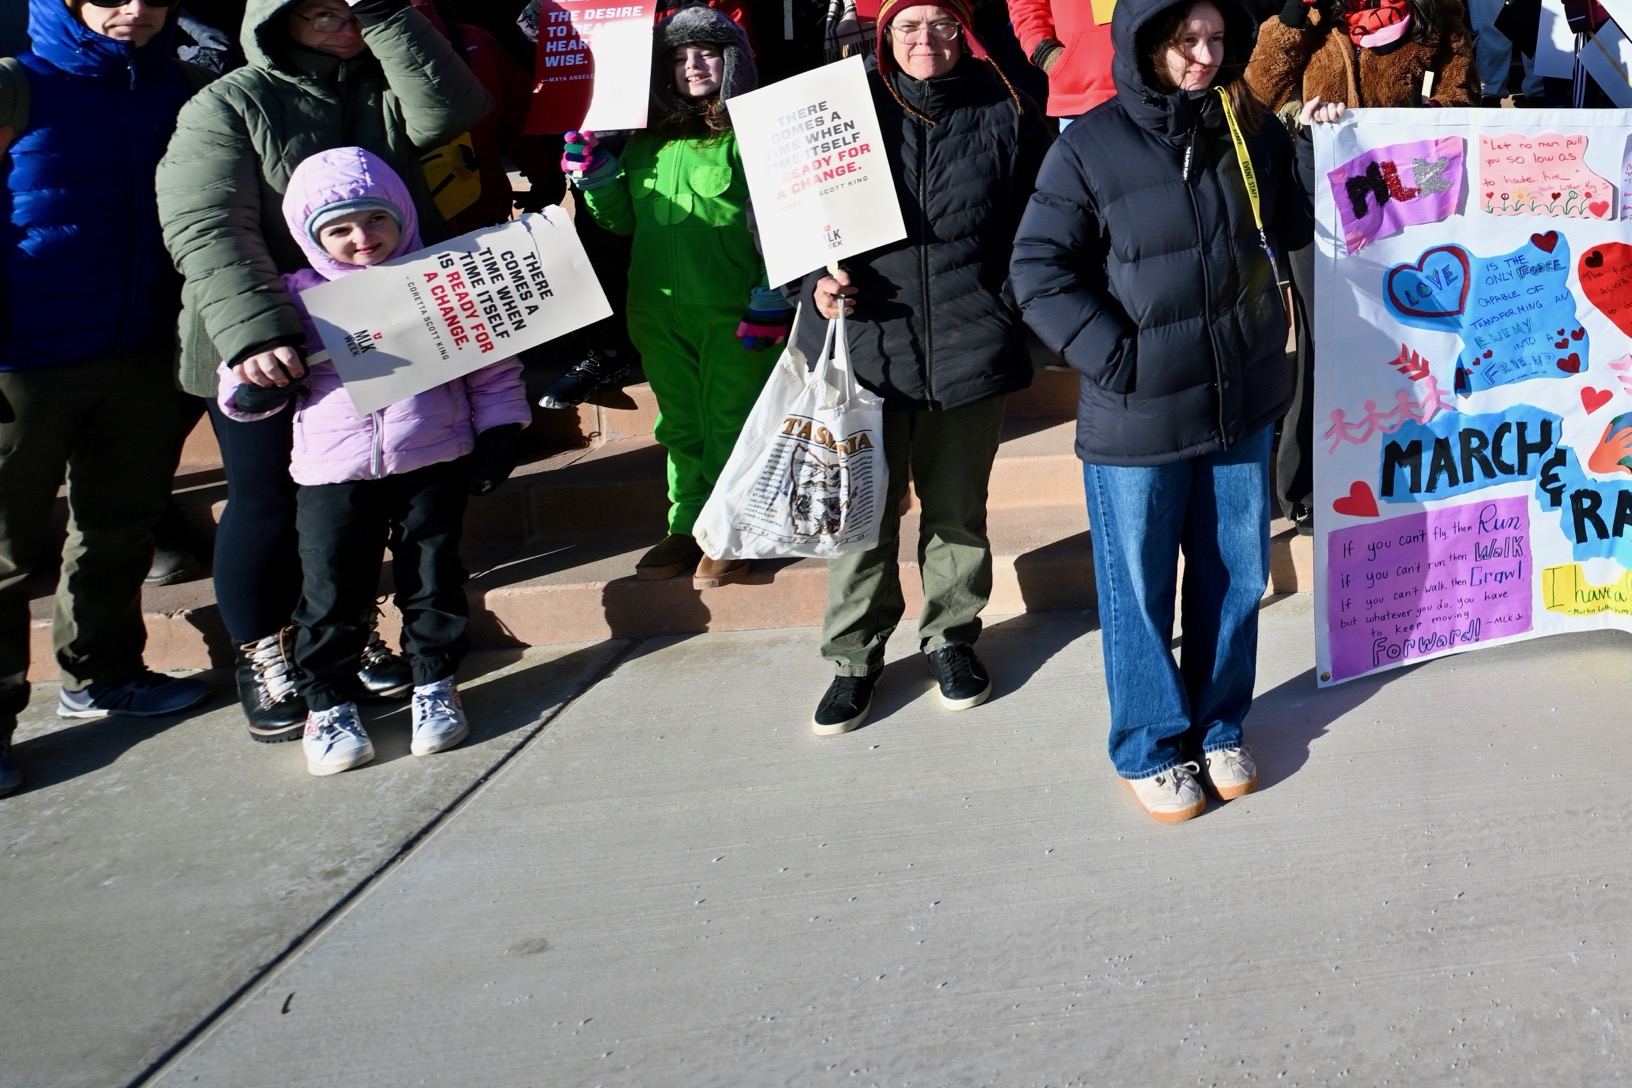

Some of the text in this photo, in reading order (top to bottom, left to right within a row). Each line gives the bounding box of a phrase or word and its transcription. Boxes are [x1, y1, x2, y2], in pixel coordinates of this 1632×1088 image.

[1345, 155, 1454, 220] MLK
[423, 271, 470, 351] A CHANGE.
[437, 253, 495, 354] IS READY FOR
[459, 251, 510, 339] TIME ITSELF
[479, 247, 527, 331] TIME WHEN
[501, 250, 540, 316] COMES A
[522, 251, 554, 300] THERE
[344, 335, 361, 358] WEEK
[353, 329, 376, 354] MLK
[407, 282, 450, 361] CORETTA SCOTT KING
[1380, 419, 1553, 497] MARCH
[1540, 447, 1567, 507] &
